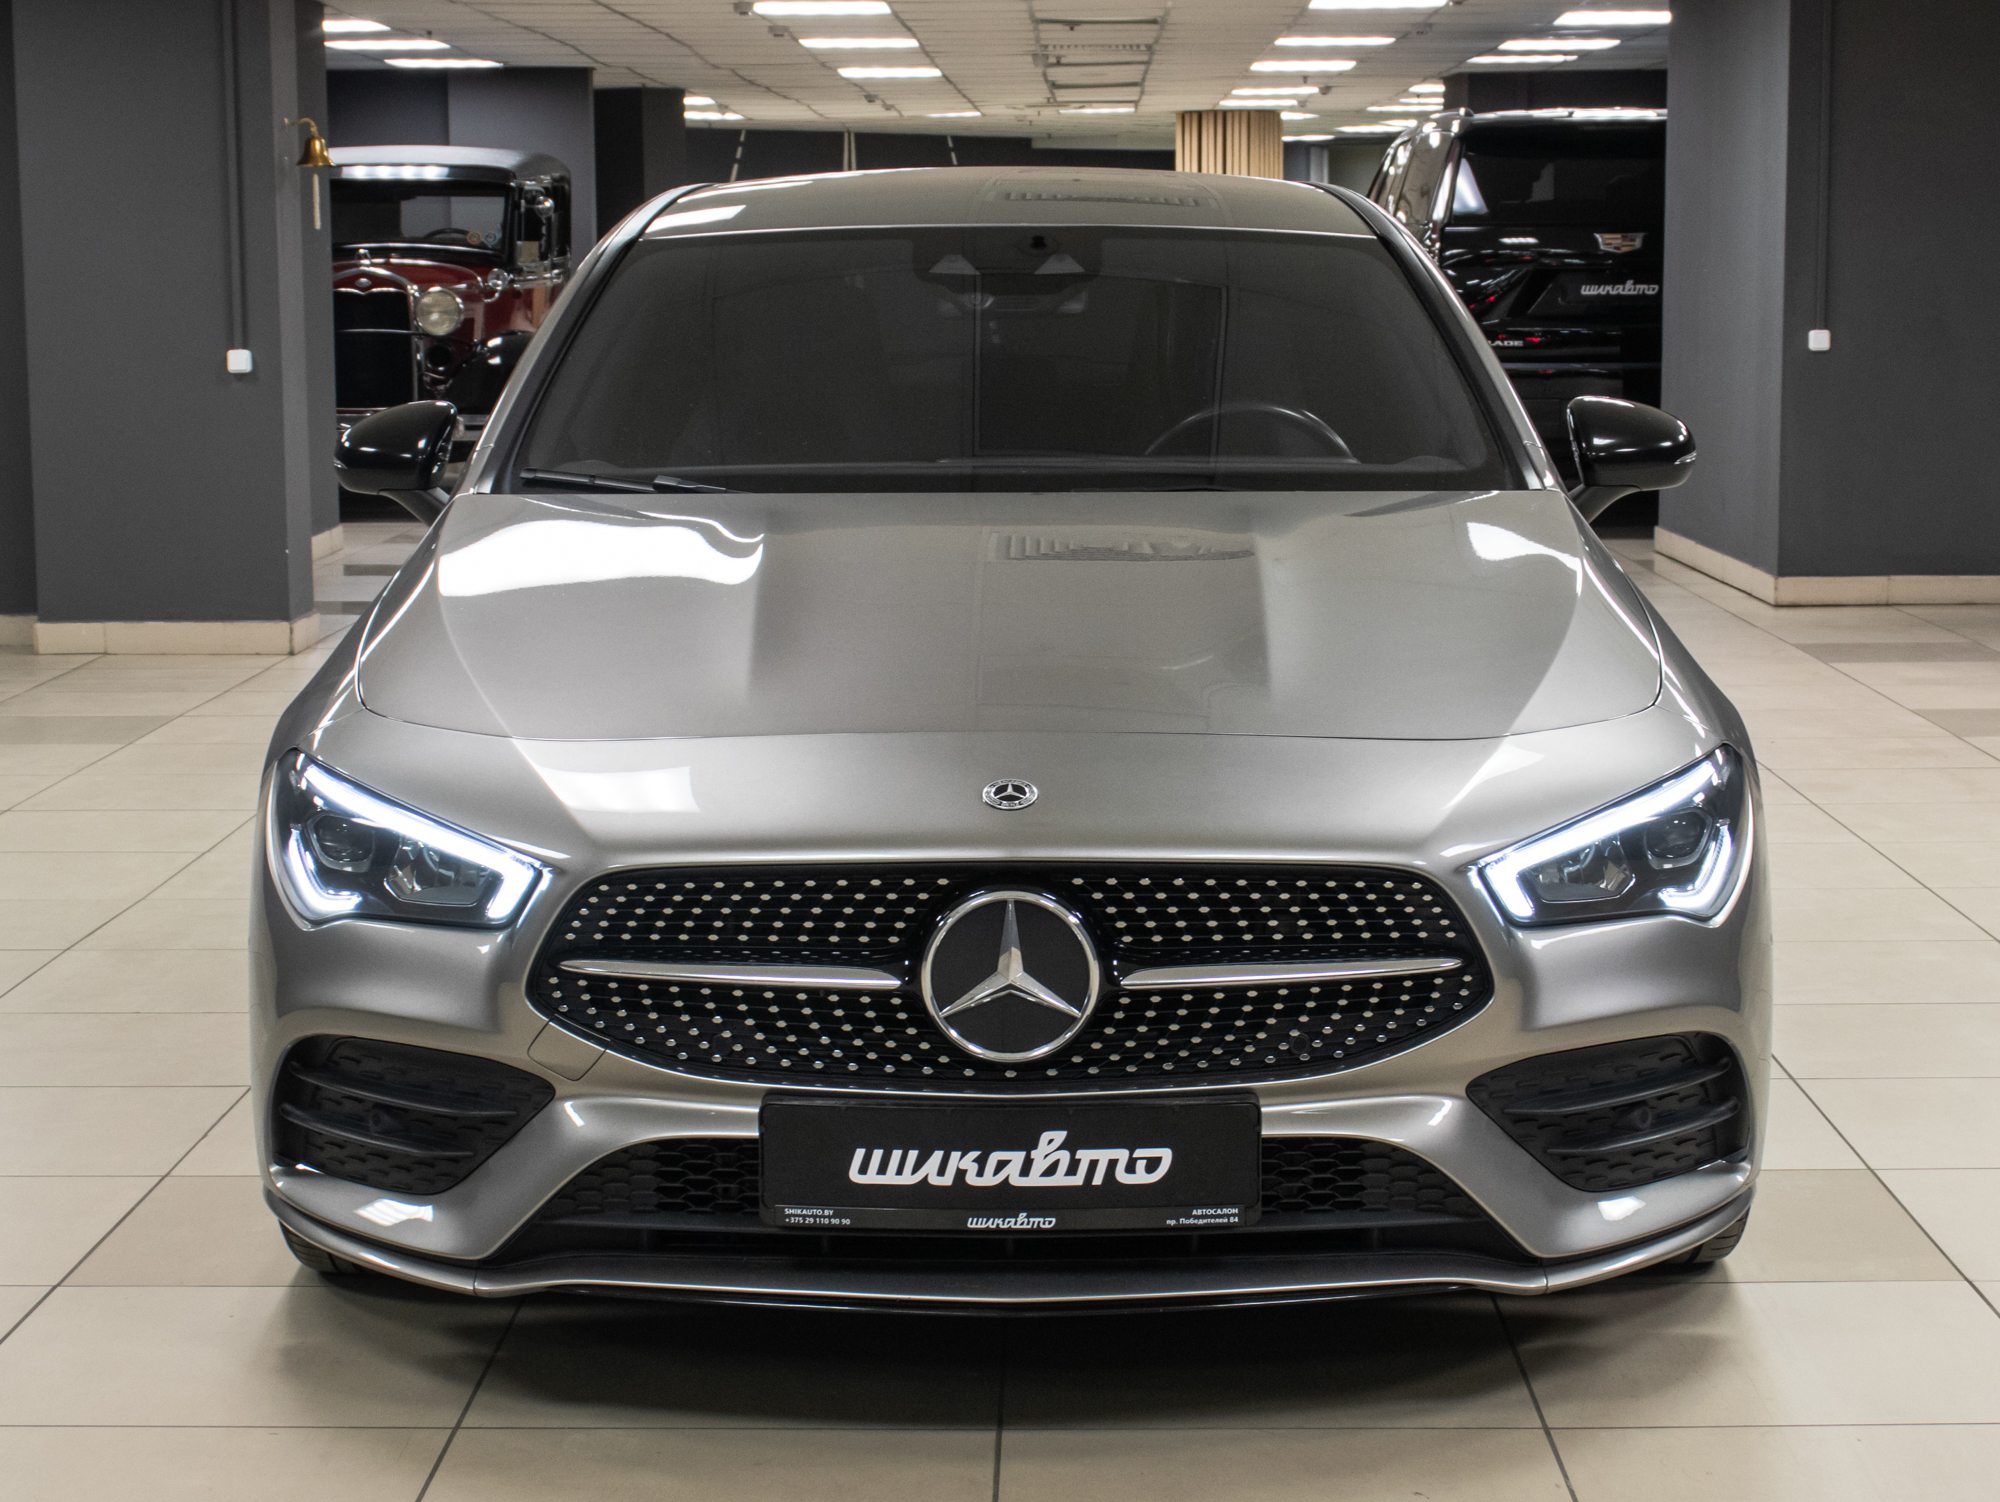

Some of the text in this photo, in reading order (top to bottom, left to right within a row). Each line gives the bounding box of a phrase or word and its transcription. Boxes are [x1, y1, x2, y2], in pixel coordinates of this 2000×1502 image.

[784, 1208, 834, 1216] SHIKAUTO.BY
[1192, 1207, 1239, 1216] АВТОСАЛОН
[785, 1216, 804, 1224] +375
[816, 1217, 829, 1225] 110
[841, 1218, 851, 1226] 90
[1179, 1216, 1228, 1225] Победителей
